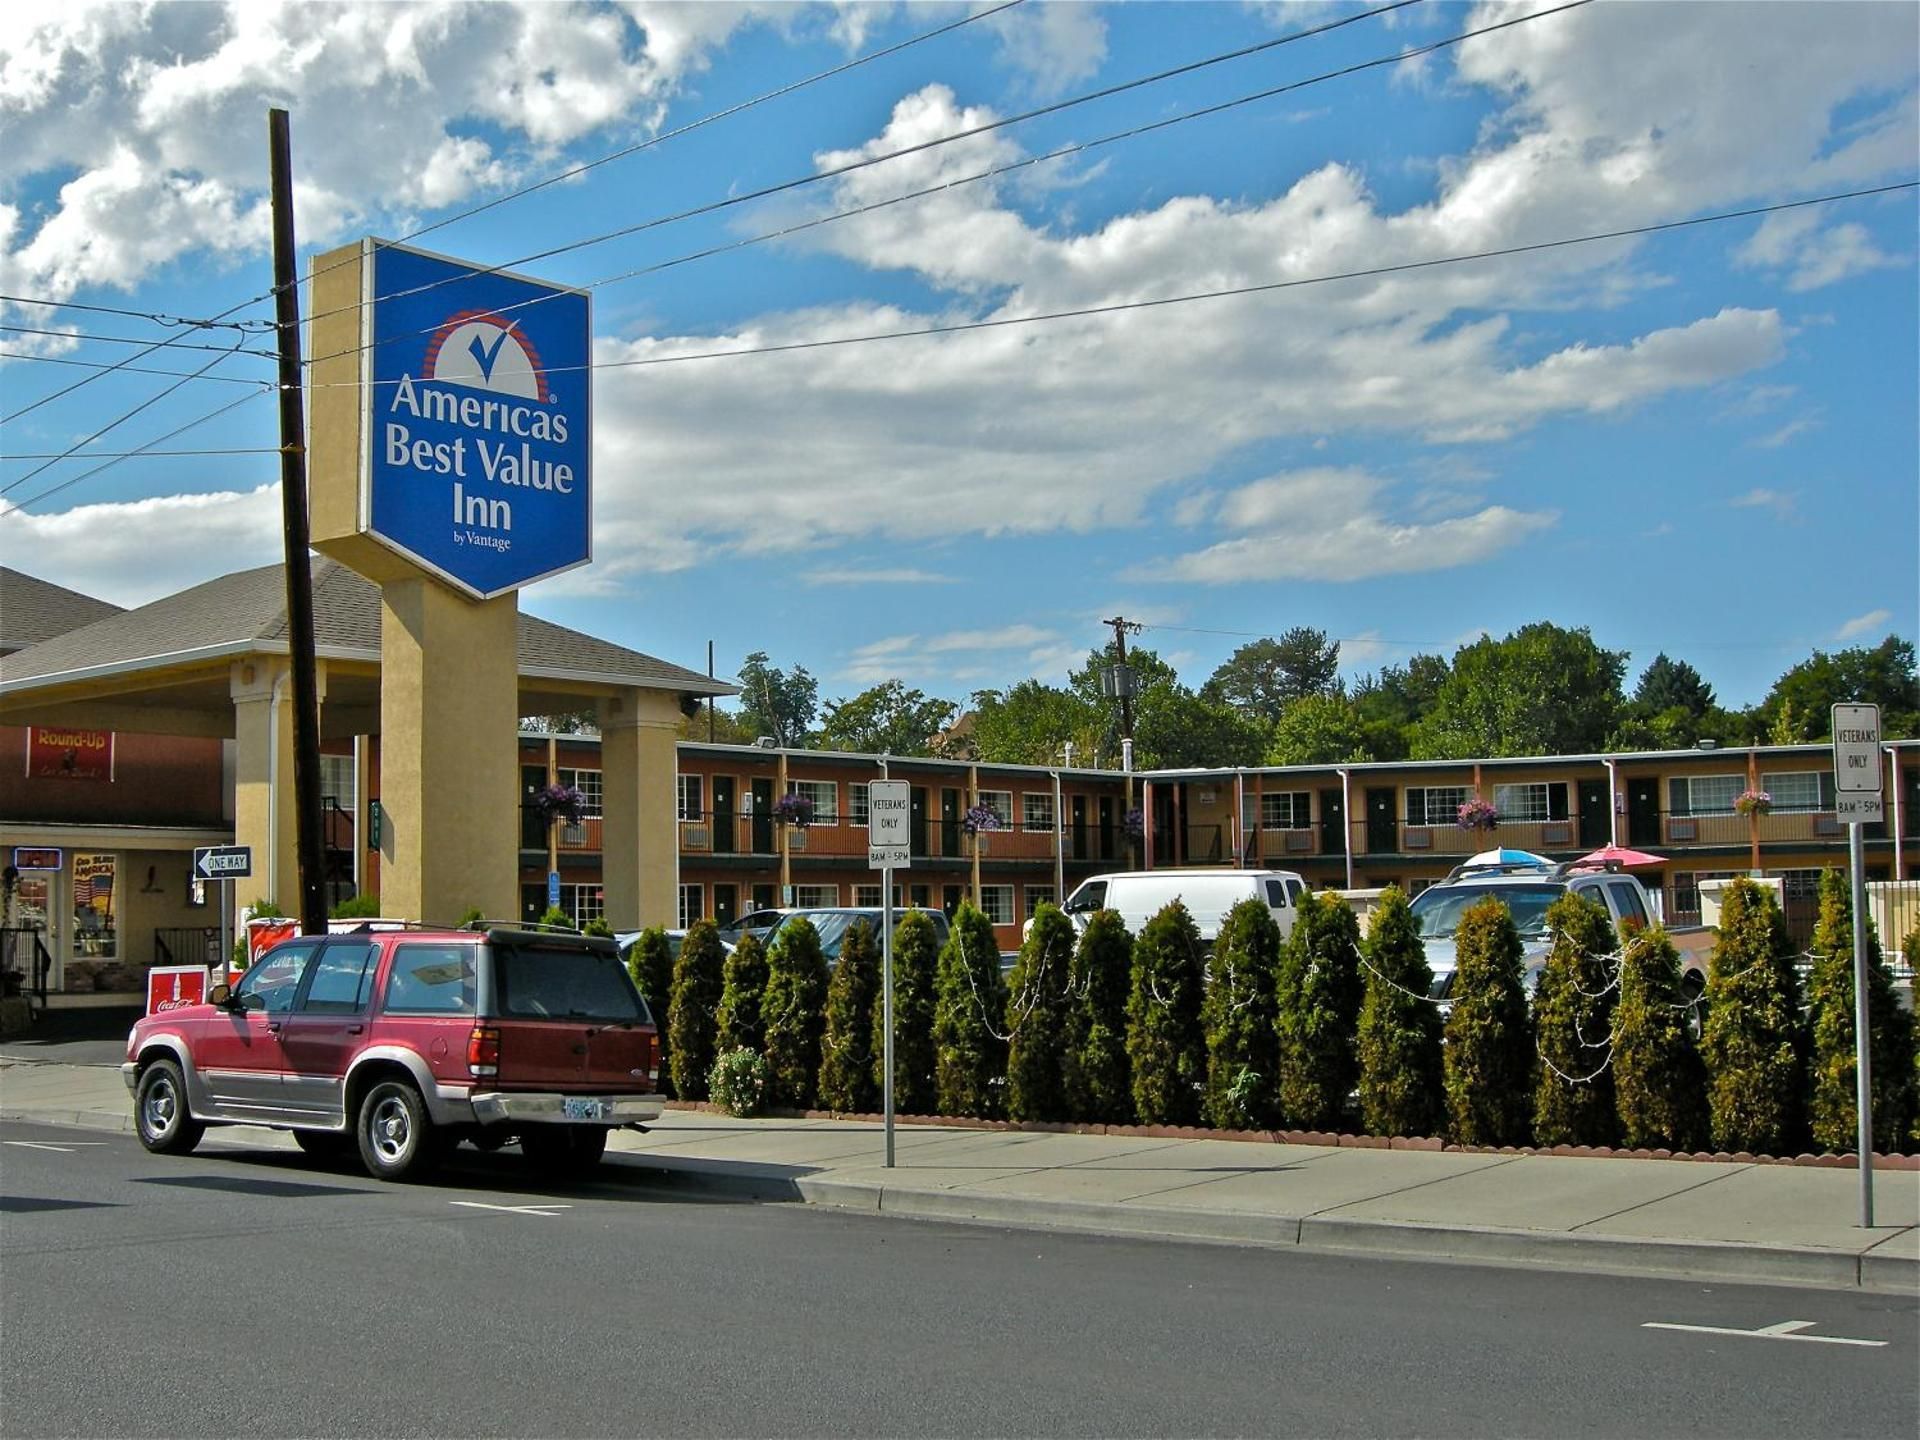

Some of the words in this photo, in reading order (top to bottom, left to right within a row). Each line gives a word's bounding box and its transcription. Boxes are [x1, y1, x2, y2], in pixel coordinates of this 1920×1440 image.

[390, 373, 568, 444] Americas
[386, 423, 466, 477] Best
[476, 438, 573, 494] Value
[454, 482, 511, 531] Inn
[453, 530, 465, 546] by
[466, 530, 511, 552] Vantage
[39, 728, 105, 750] Round-Up
[1837, 729, 1876, 743] VETERANS
[1848, 754, 1868, 768] ONLY
[872, 799, 906, 810] VETERANS
[1838, 802, 1856, 814] 8AM
[1864, 800, 1881, 813] 5PM
[881, 818, 898, 829] ONLY
[208, 857, 226, 869] ONE
[227, 856, 245, 868] WAY
[871, 852, 885, 862] 8AM
[894, 851, 908, 861] 5PM
